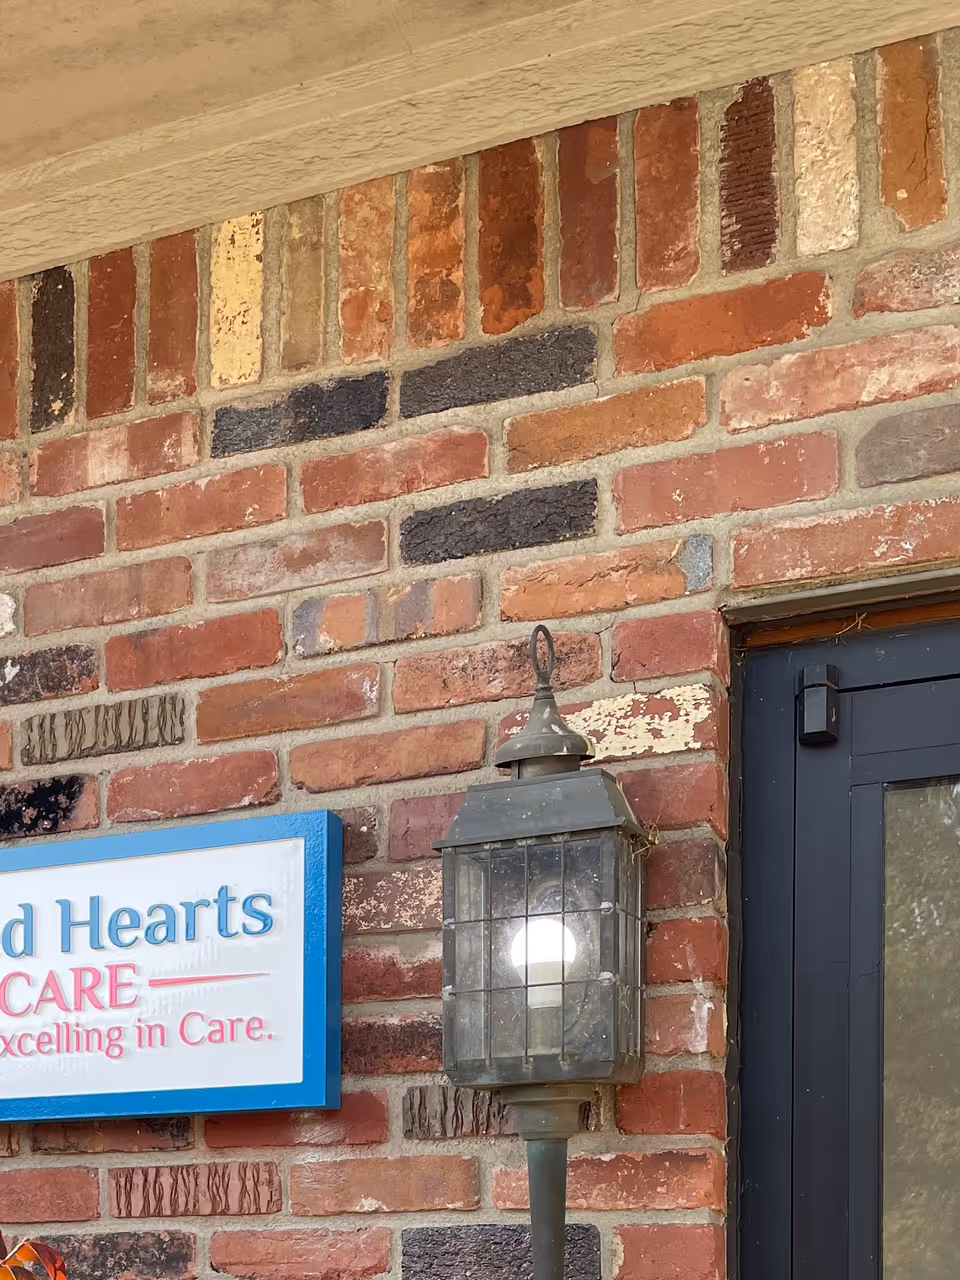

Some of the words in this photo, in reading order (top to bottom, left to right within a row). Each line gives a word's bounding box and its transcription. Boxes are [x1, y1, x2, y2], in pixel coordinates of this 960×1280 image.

[55, 885, 274, 953] Hearts
[136, 1016, 165, 1048] in
[178, 1012, 274, 1046] Care.
